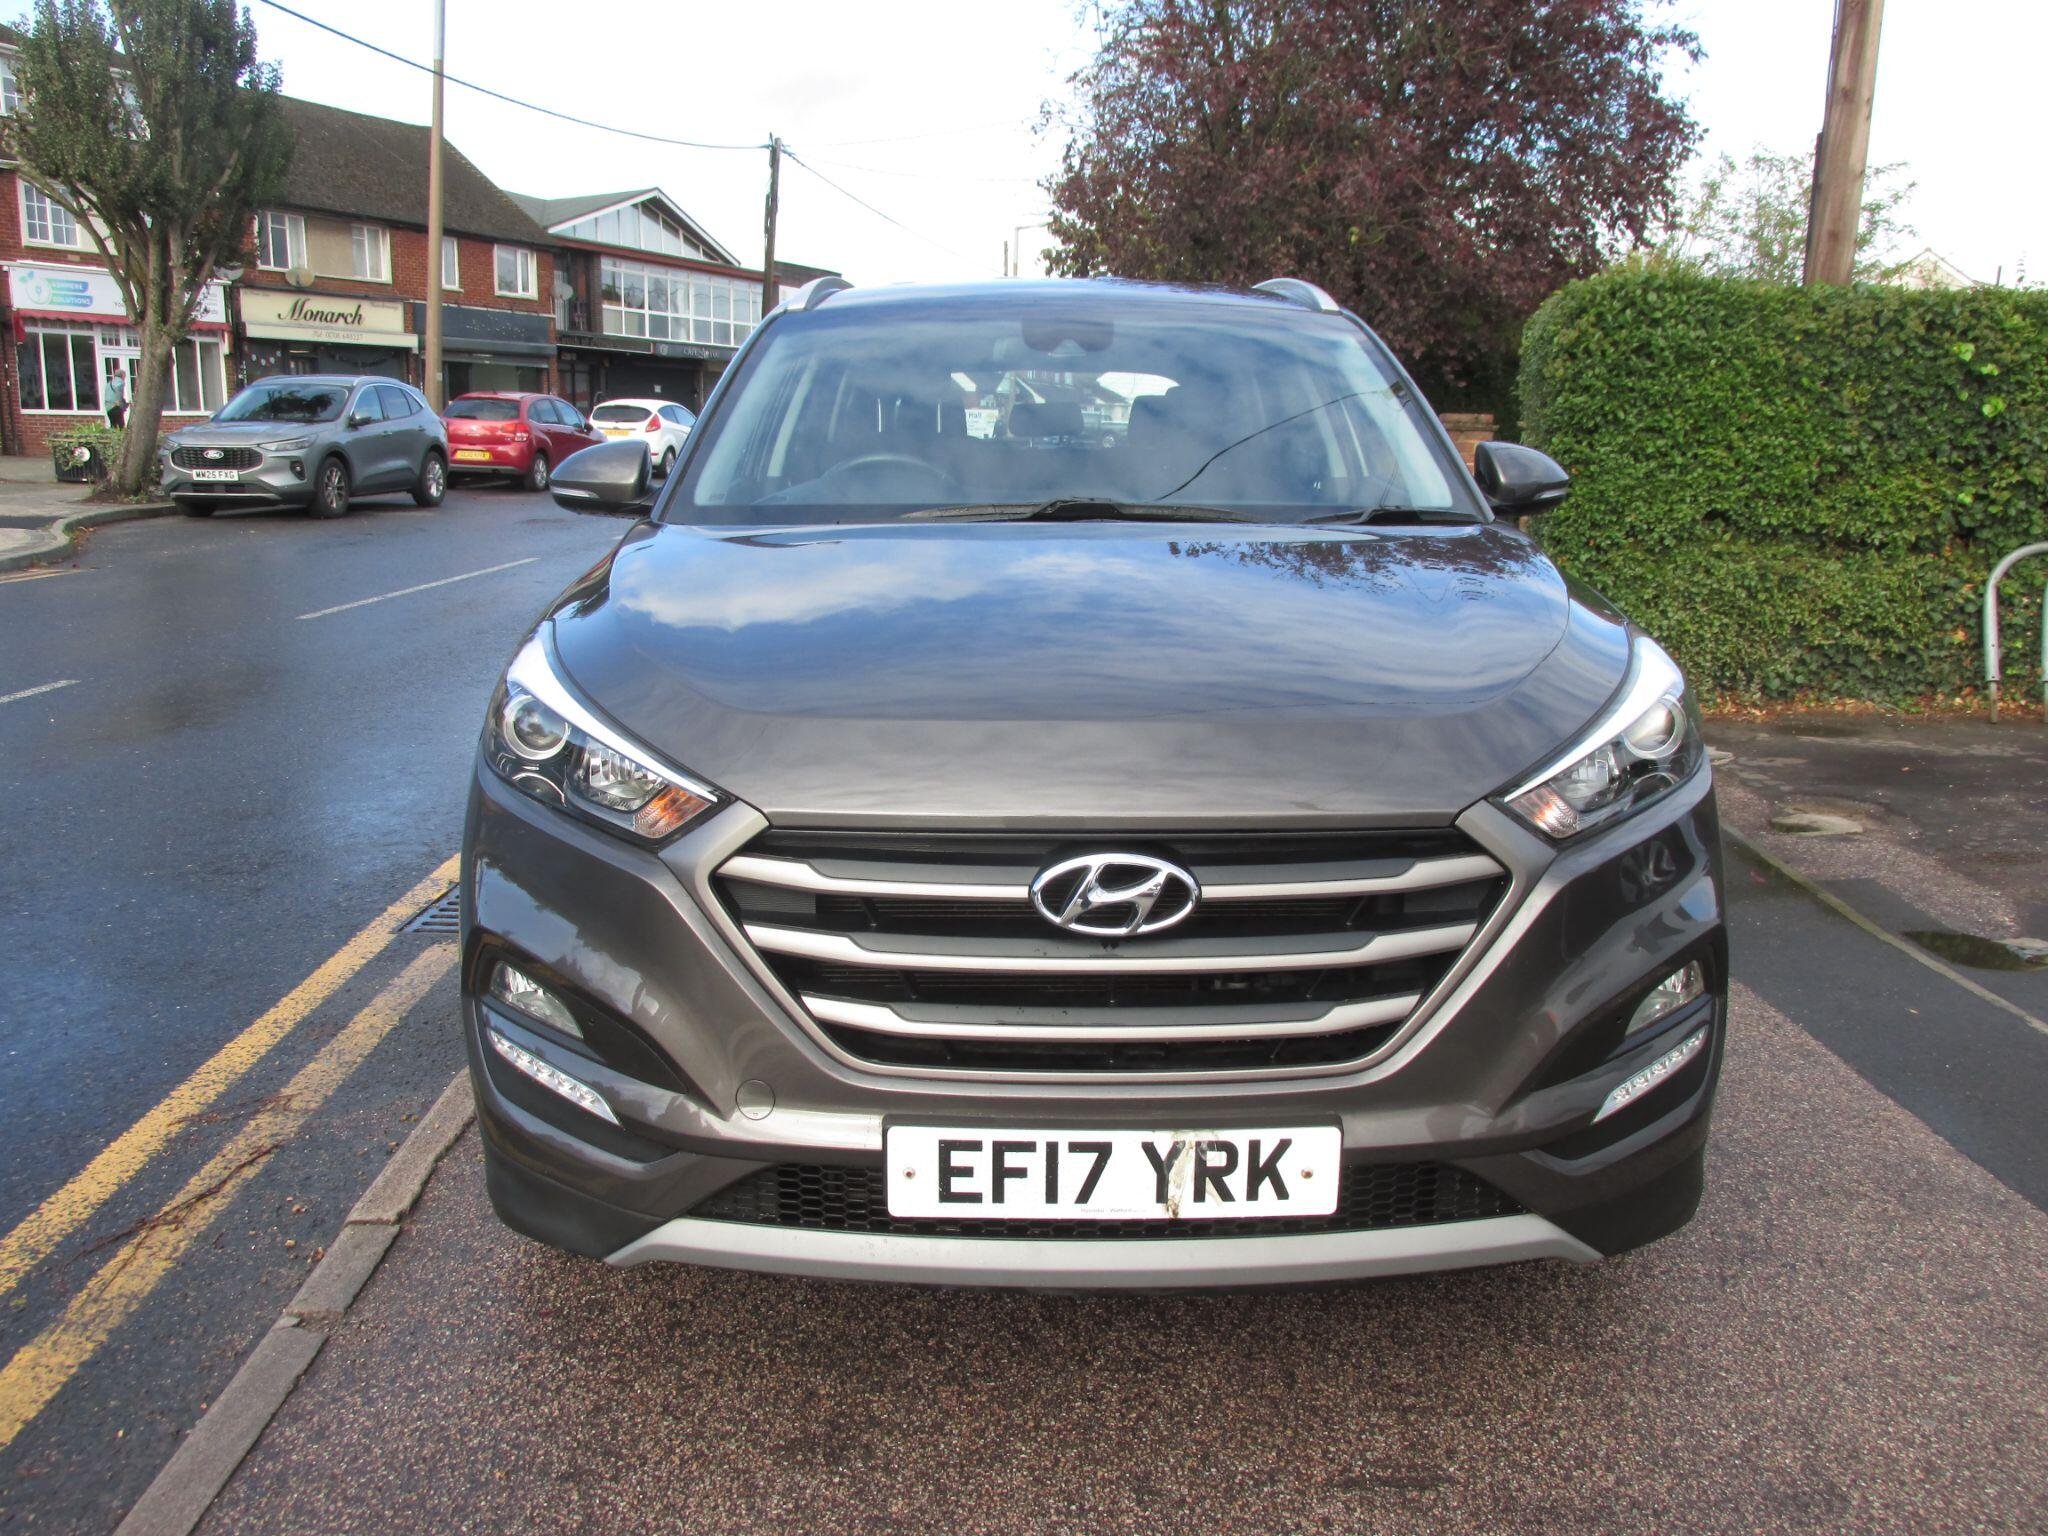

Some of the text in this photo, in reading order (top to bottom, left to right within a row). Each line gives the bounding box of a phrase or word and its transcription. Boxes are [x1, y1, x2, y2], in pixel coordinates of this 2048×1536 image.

[278, 299, 364, 326] Monarch
[938, 1137, 1293, 1205] EF17 YRK
